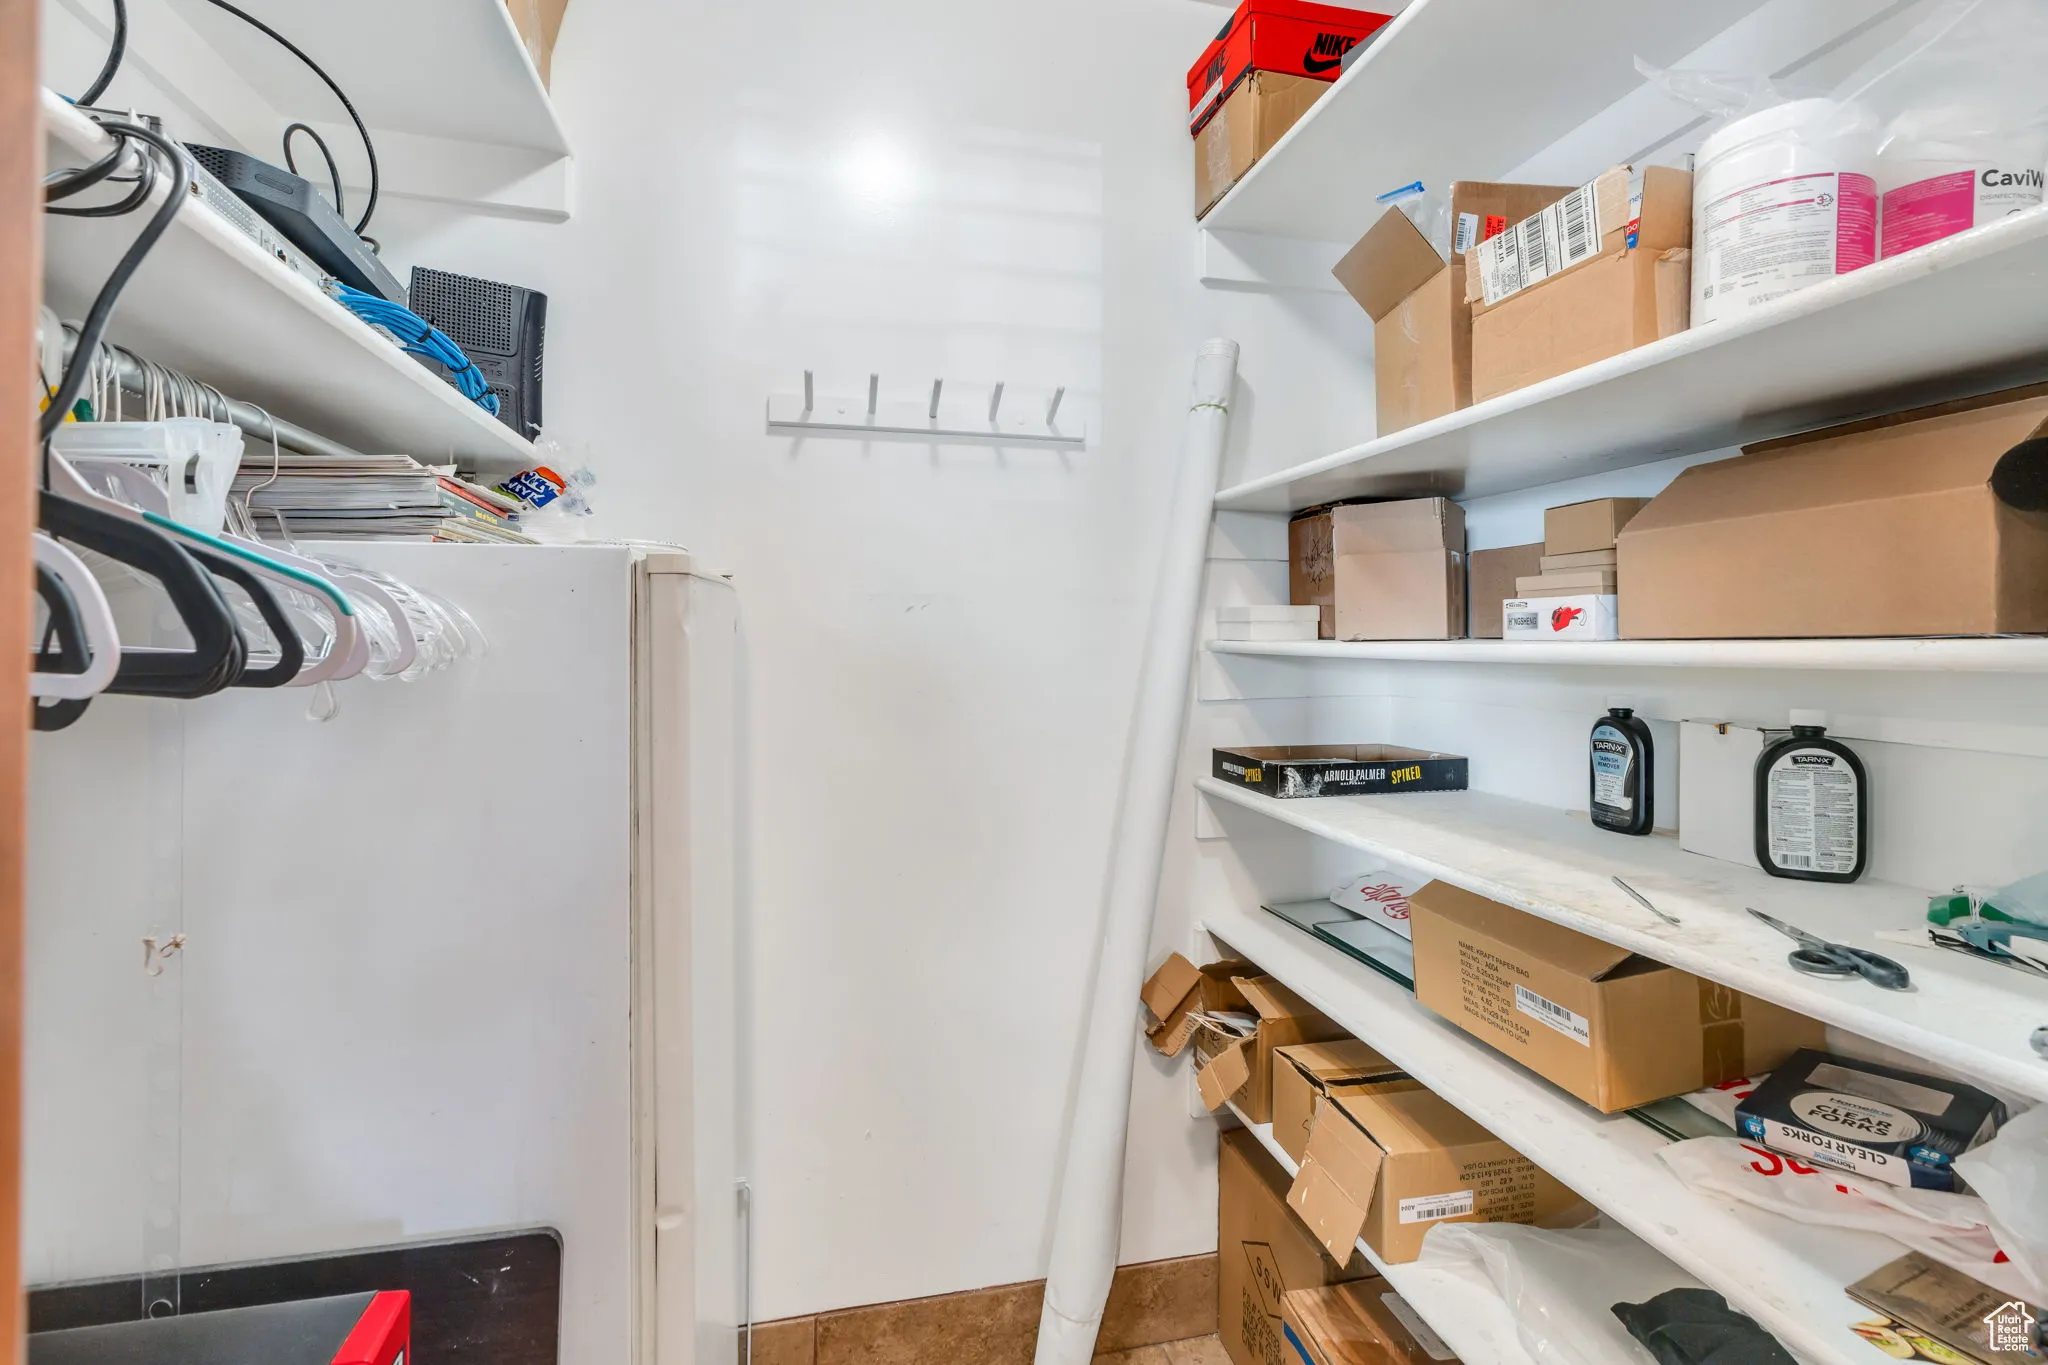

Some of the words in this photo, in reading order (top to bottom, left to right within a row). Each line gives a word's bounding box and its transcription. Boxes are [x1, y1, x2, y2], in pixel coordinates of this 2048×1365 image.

[1312, 33, 1356, 57] NIKE
[1324, 769, 1354, 782] ARNOLD
[1355, 768, 1386, 781] PALMER
[1391, 765, 1421, 785] SPIKED
[1476, 949, 1495, 961] KRAFT
[1495, 957, 1515, 971] PAPER
[1515, 966, 1530, 978] BAG
[1477, 984, 1487, 994] 100
[1487, 990, 1500, 1002] PCS
[1482, 980, 1501, 993] WHITE
[1463, 1003, 1480, 1018] MADE
[1486, 1017, 1506, 1033] CHINA
[1505, 1027, 1514, 1037] TO
[1514, 1033, 1528, 1045] USA
[1519, 1026, 1530, 1037] CM
[1573, 1025, 1588, 1038] A004
[1808, 1108, 1892, 1137] FORKS
[1815, 1103, 1893, 1129] CLEAR
[1781, 1126, 1832, 1150] FORKS
[1834, 1141, 1888, 1166] CLEAR
[1463, 1163, 1476, 1171] USA
[1488, 1159, 1507, 1167] CHINA
[1480, 1180, 1494, 1188] LBS
[1505, 1186, 1516, 1194] 100
[1488, 1196, 1509, 1205] WHITE
